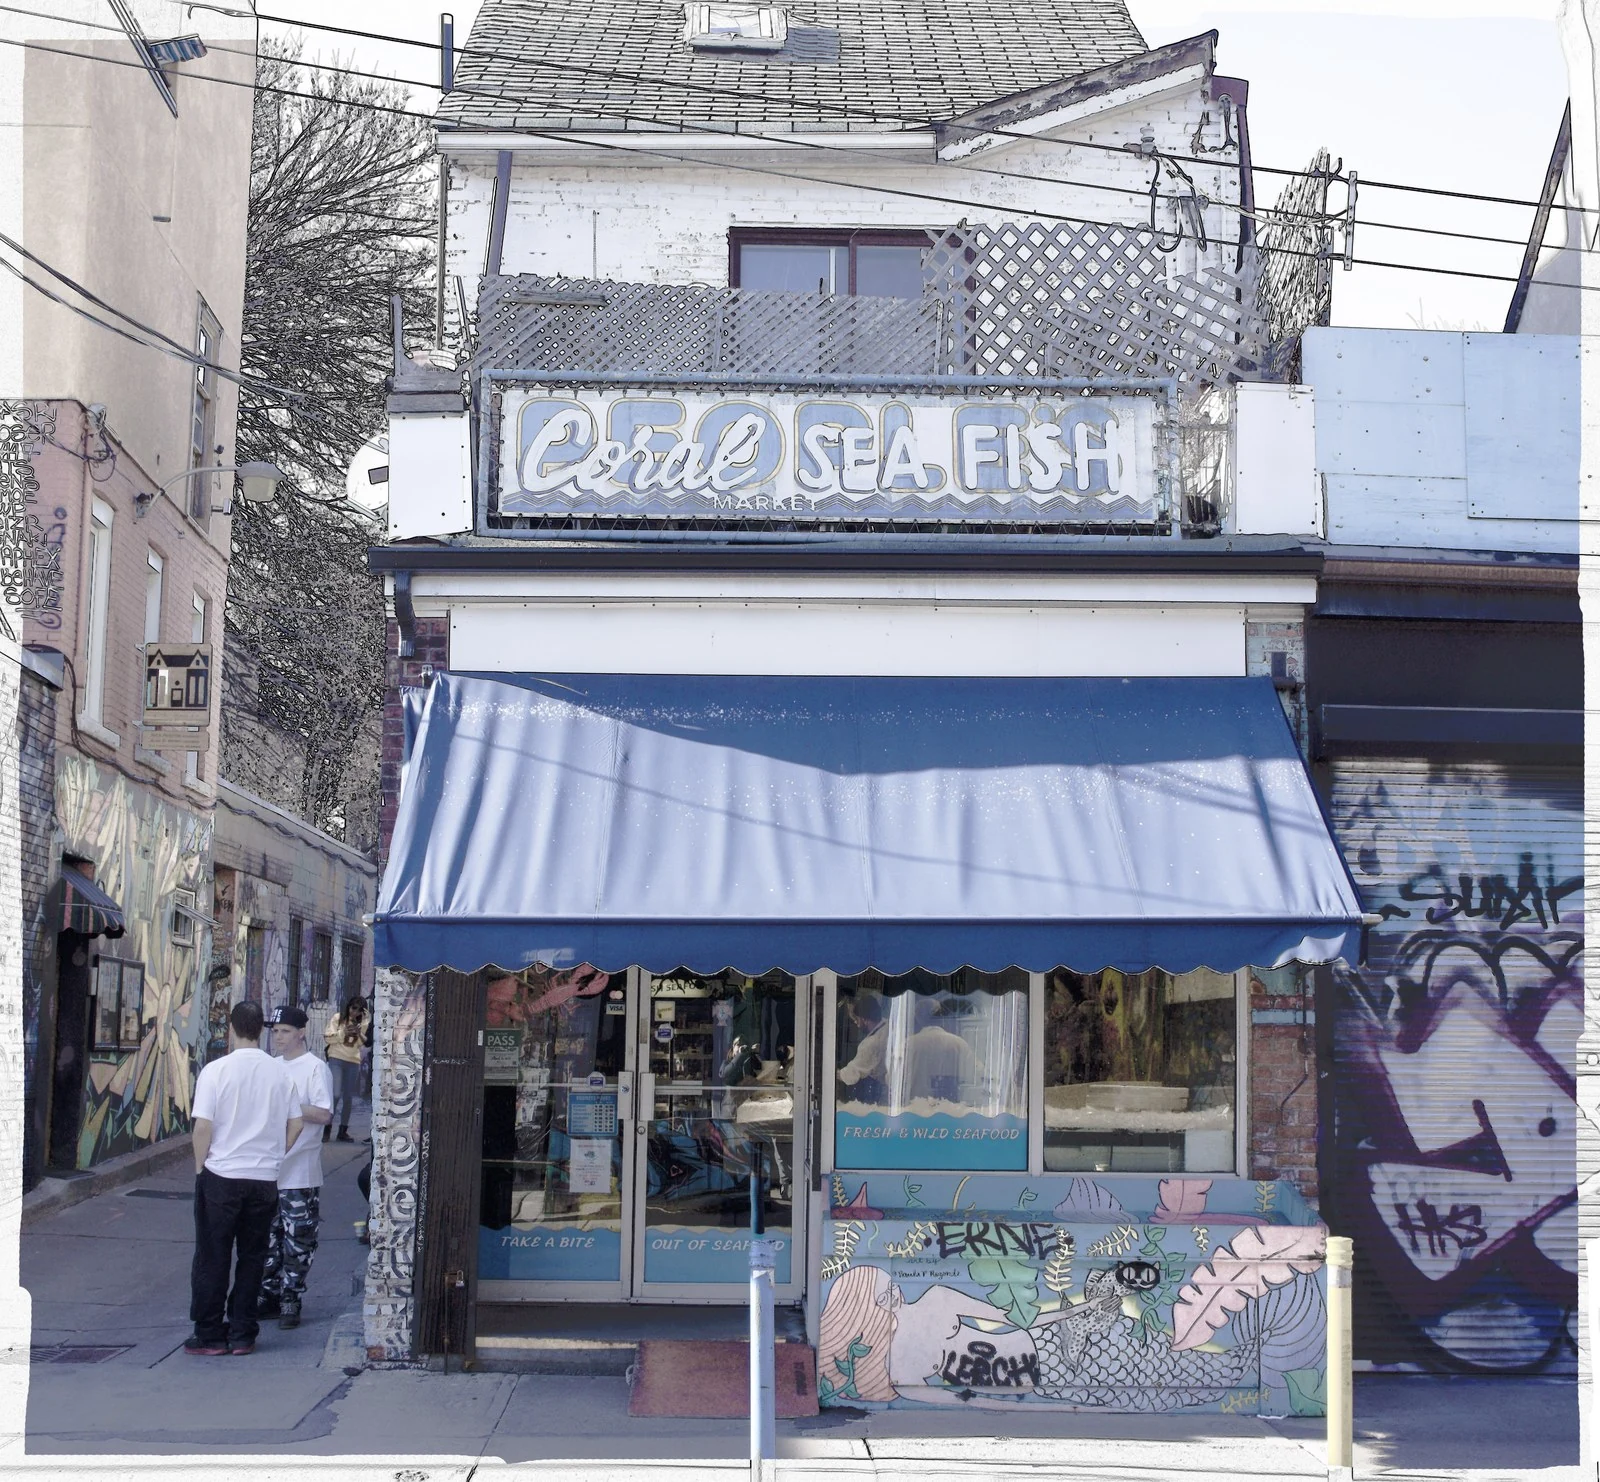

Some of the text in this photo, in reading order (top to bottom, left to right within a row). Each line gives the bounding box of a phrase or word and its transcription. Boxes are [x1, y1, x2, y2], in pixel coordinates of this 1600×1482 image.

[518, 408, 1121, 496] Coral SEA FISH
[712, 494, 818, 512] MARKET
[487, 1035, 515, 1046] PASS
[843, 1127, 892, 1138] FRESH
[912, 1128, 949, 1139] WILD
[952, 1128, 1020, 1140] SEAFOOD
[1393, 1198, 1488, 1257] HKS
[501, 1236, 595, 1248] TAKE A BITE
[651, 1239, 785, 1251] OUT OF SEAFD
[935, 1221, 1062, 1261] ERNE
